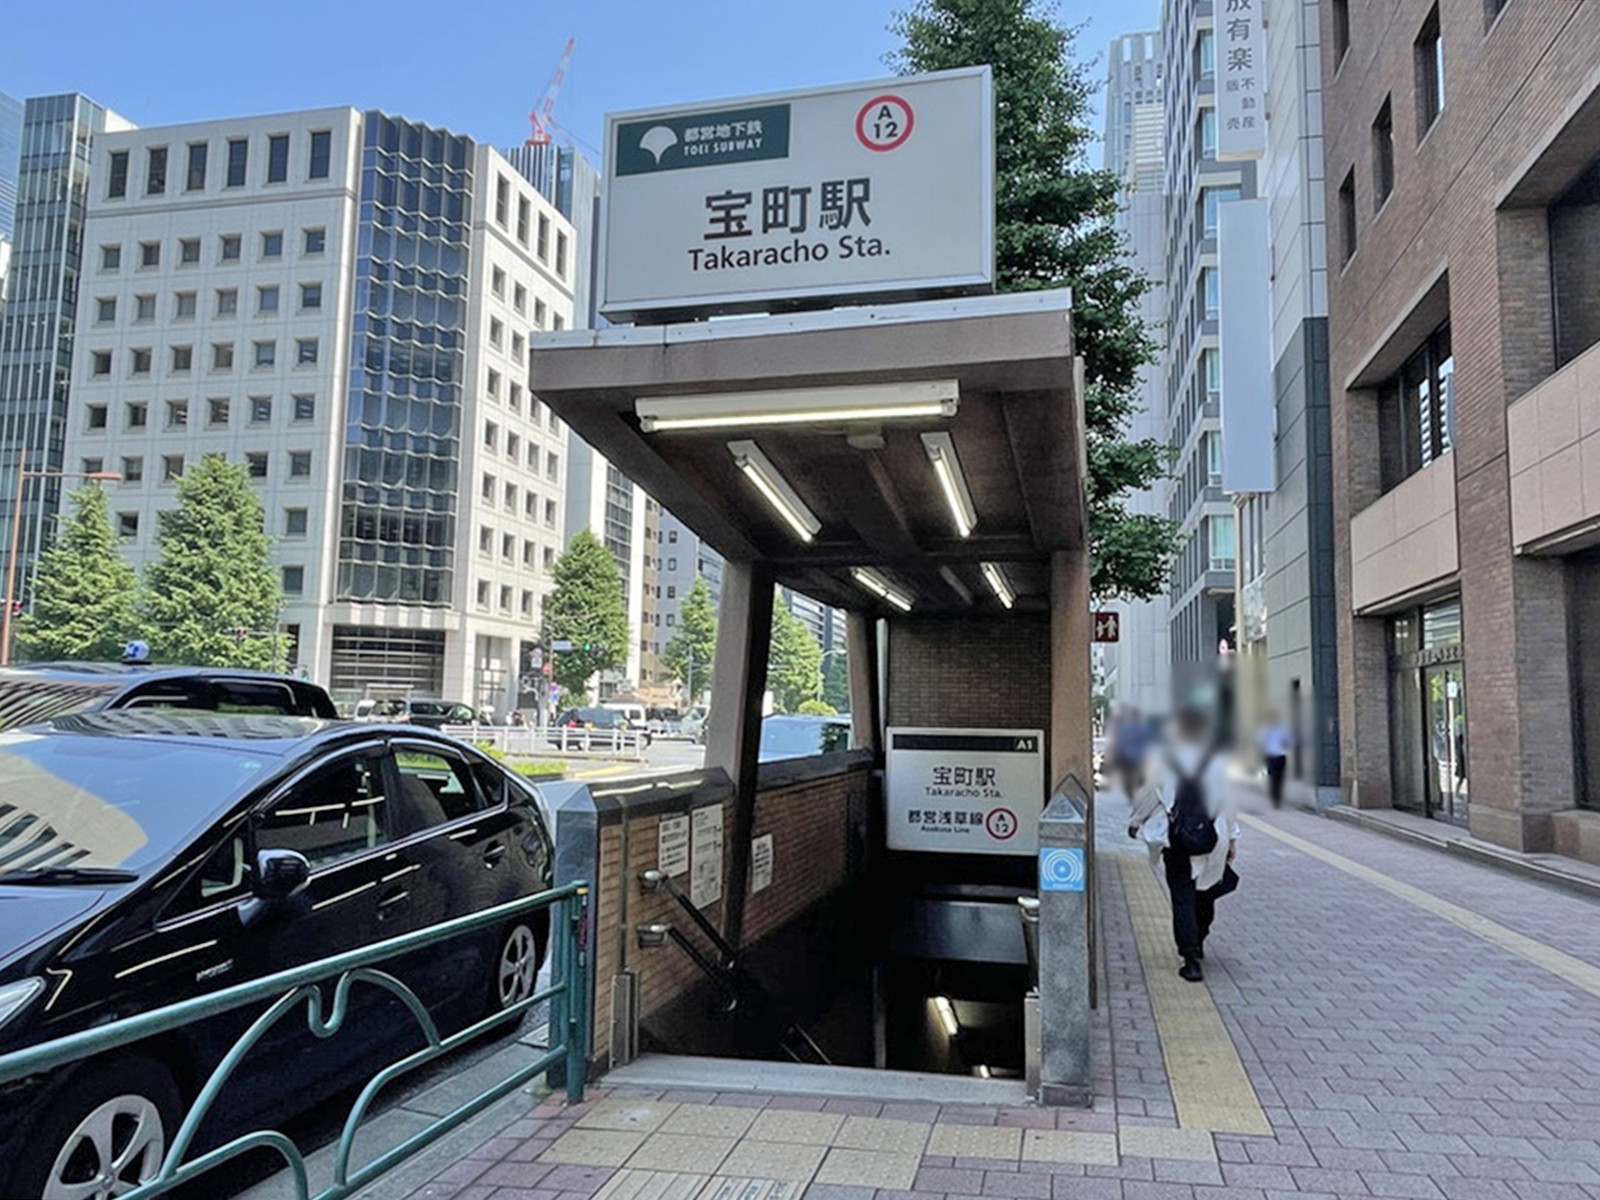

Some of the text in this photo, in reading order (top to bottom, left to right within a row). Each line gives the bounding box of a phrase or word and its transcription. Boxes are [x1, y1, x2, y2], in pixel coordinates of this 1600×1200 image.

[877, 105, 892, 120] A
[684, 120, 763, 142] 都営地下鉄
[873, 122, 898, 140] 12
[684, 138, 763, 156] TOEI SUBWAY
[703, 177, 872, 241] 宝町駅
[688, 235, 890, 271] Takaracho Sta.
[932, 766, 996, 787] 宝町駅
[925, 786, 1003, 799] Takaracho Sta.
[908, 810, 984, 825] 都営浅草線
[998, 814, 1006, 822] A
[994, 824, 1010, 833] 12
